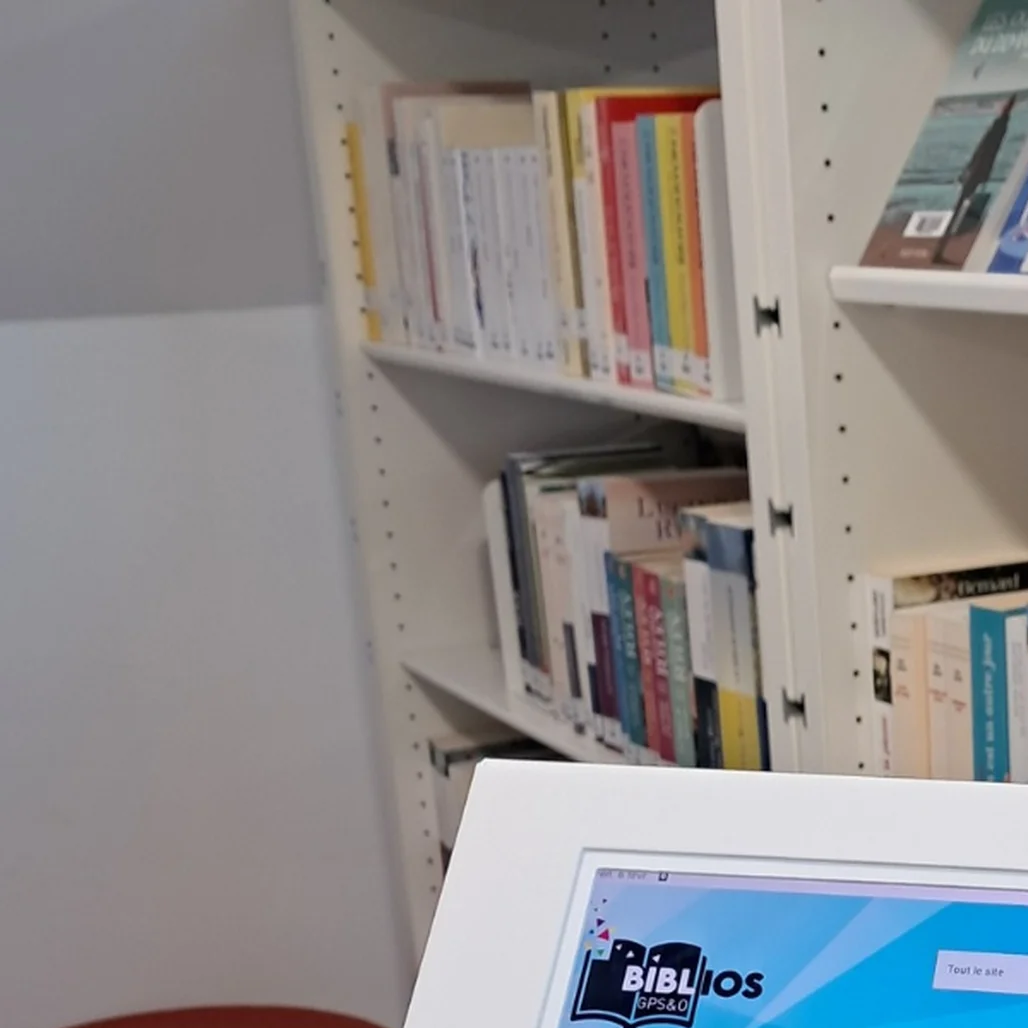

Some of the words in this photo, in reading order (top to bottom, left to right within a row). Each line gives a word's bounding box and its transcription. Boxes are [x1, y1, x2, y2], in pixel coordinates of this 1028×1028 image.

[948, 963, 972, 976] Tout
[973, 964, 983, 976] le
[985, 966, 1005, 978] site
[621, 964, 765, 1000] BIBLIOS
[637, 996, 689, 1012] GPS&O
